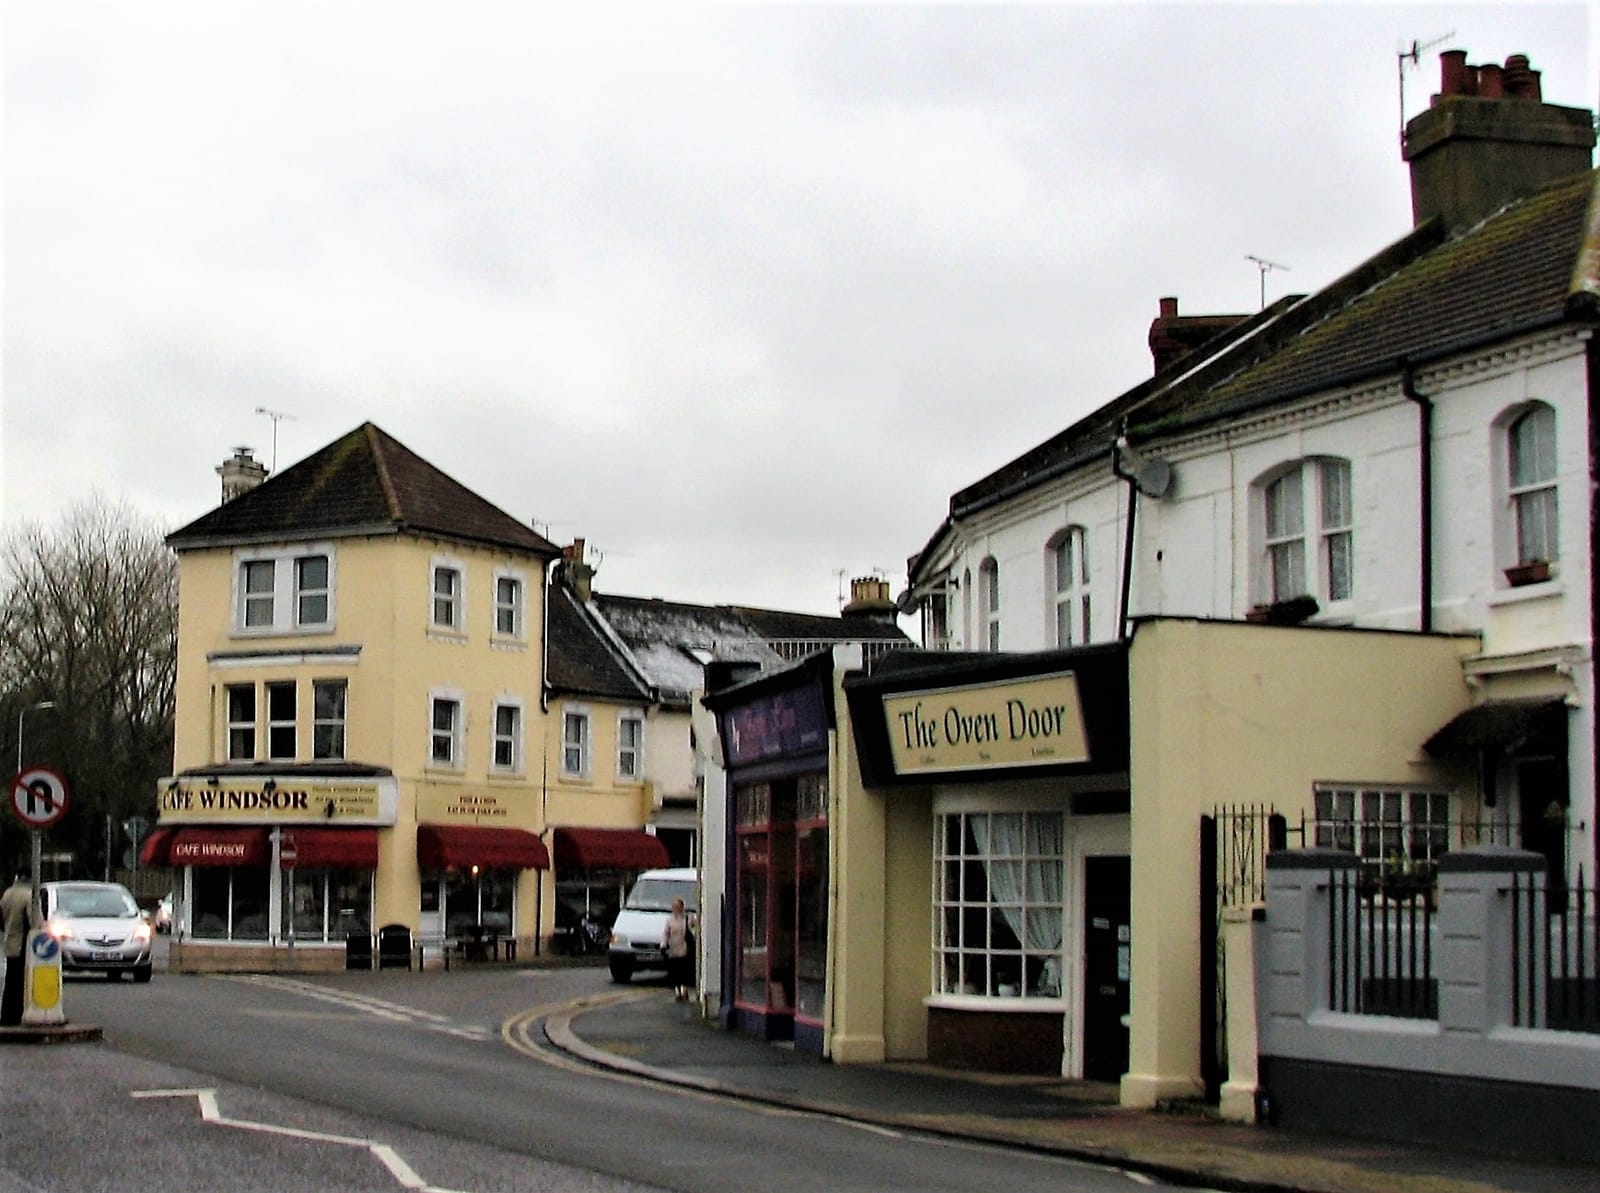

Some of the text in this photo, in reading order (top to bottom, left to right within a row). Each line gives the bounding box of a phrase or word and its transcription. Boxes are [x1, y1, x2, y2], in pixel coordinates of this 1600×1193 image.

[899, 699, 1066, 749] The Oven Door
[199, 790, 308, 810] WINDSOR
[202, 843, 245, 857] WINDSOR
